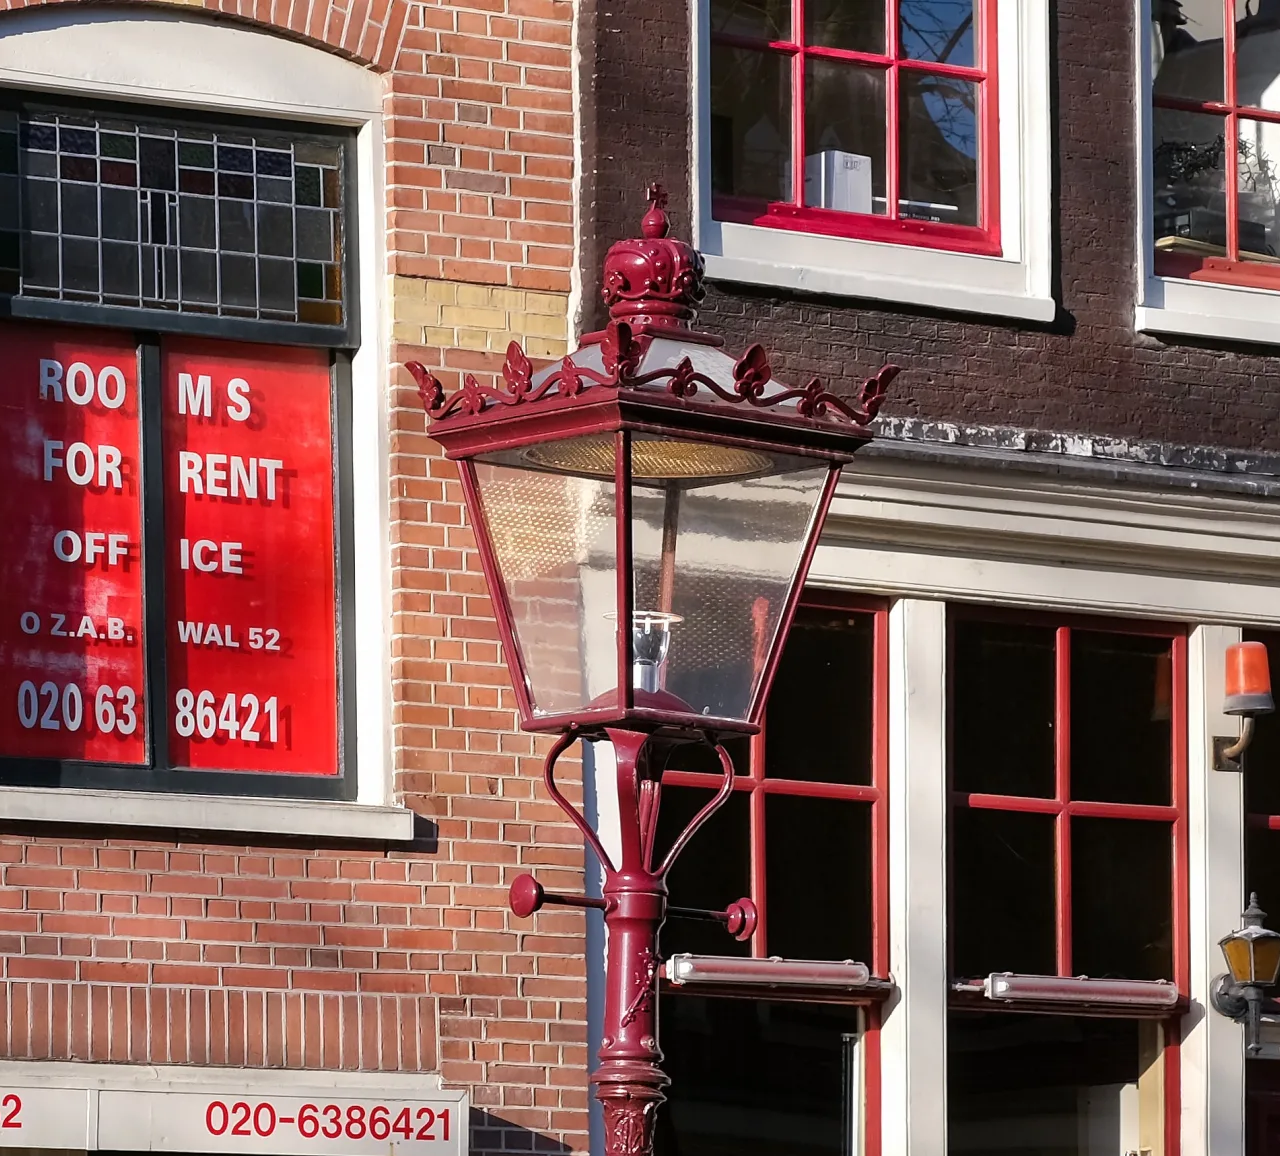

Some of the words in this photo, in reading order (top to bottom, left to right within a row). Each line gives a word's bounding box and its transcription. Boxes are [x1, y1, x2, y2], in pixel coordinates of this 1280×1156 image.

[39, 358, 126, 409] ROO
[43, 440, 123, 489] FOR
[179, 451, 283, 500] RENT
[53, 529, 128, 566] OFF
[179, 538, 243, 574] ICE
[178, 620, 239, 648] WAL
[248, 627, 280, 651] 52
[174, 688, 278, 743] 86421
[205, 1100, 451, 1142] 020-6386421
